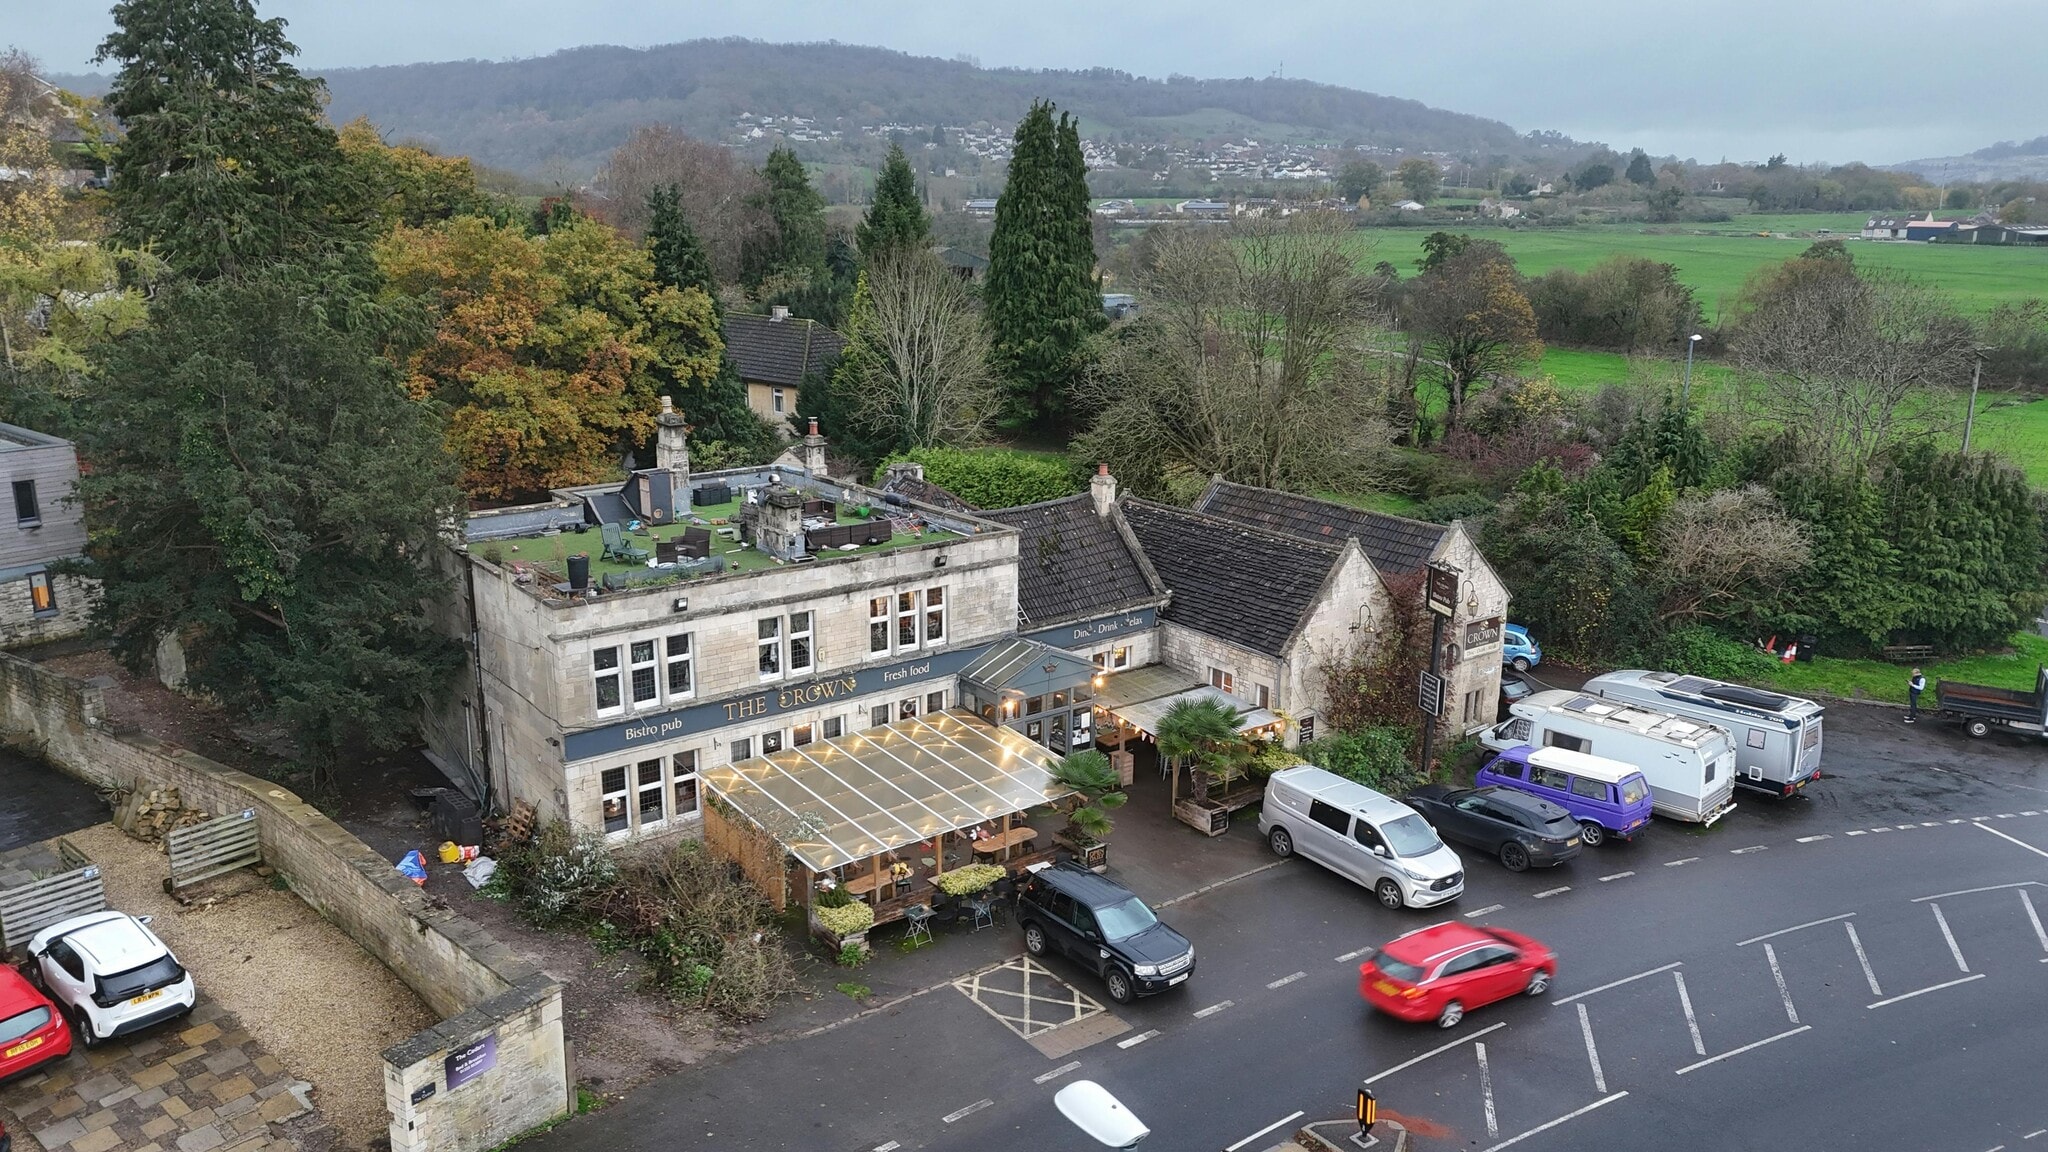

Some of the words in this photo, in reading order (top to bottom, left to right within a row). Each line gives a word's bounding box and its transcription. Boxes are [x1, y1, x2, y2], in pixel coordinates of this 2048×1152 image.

[1098, 621, 1118, 634] Drink
[1125, 616, 1143, 627] elax
[1467, 627, 1498, 644] CROWN
[884, 668, 908, 683] Fresh
[909, 662, 930, 676] food
[722, 696, 768, 721] THE
[778, 677, 856, 709] CROWN
[1735, 709, 1766, 719] Hobby
[625, 725, 658, 740] Bistro
[661, 717, 682, 736] pub
[455, 1053, 466, 1061] The
